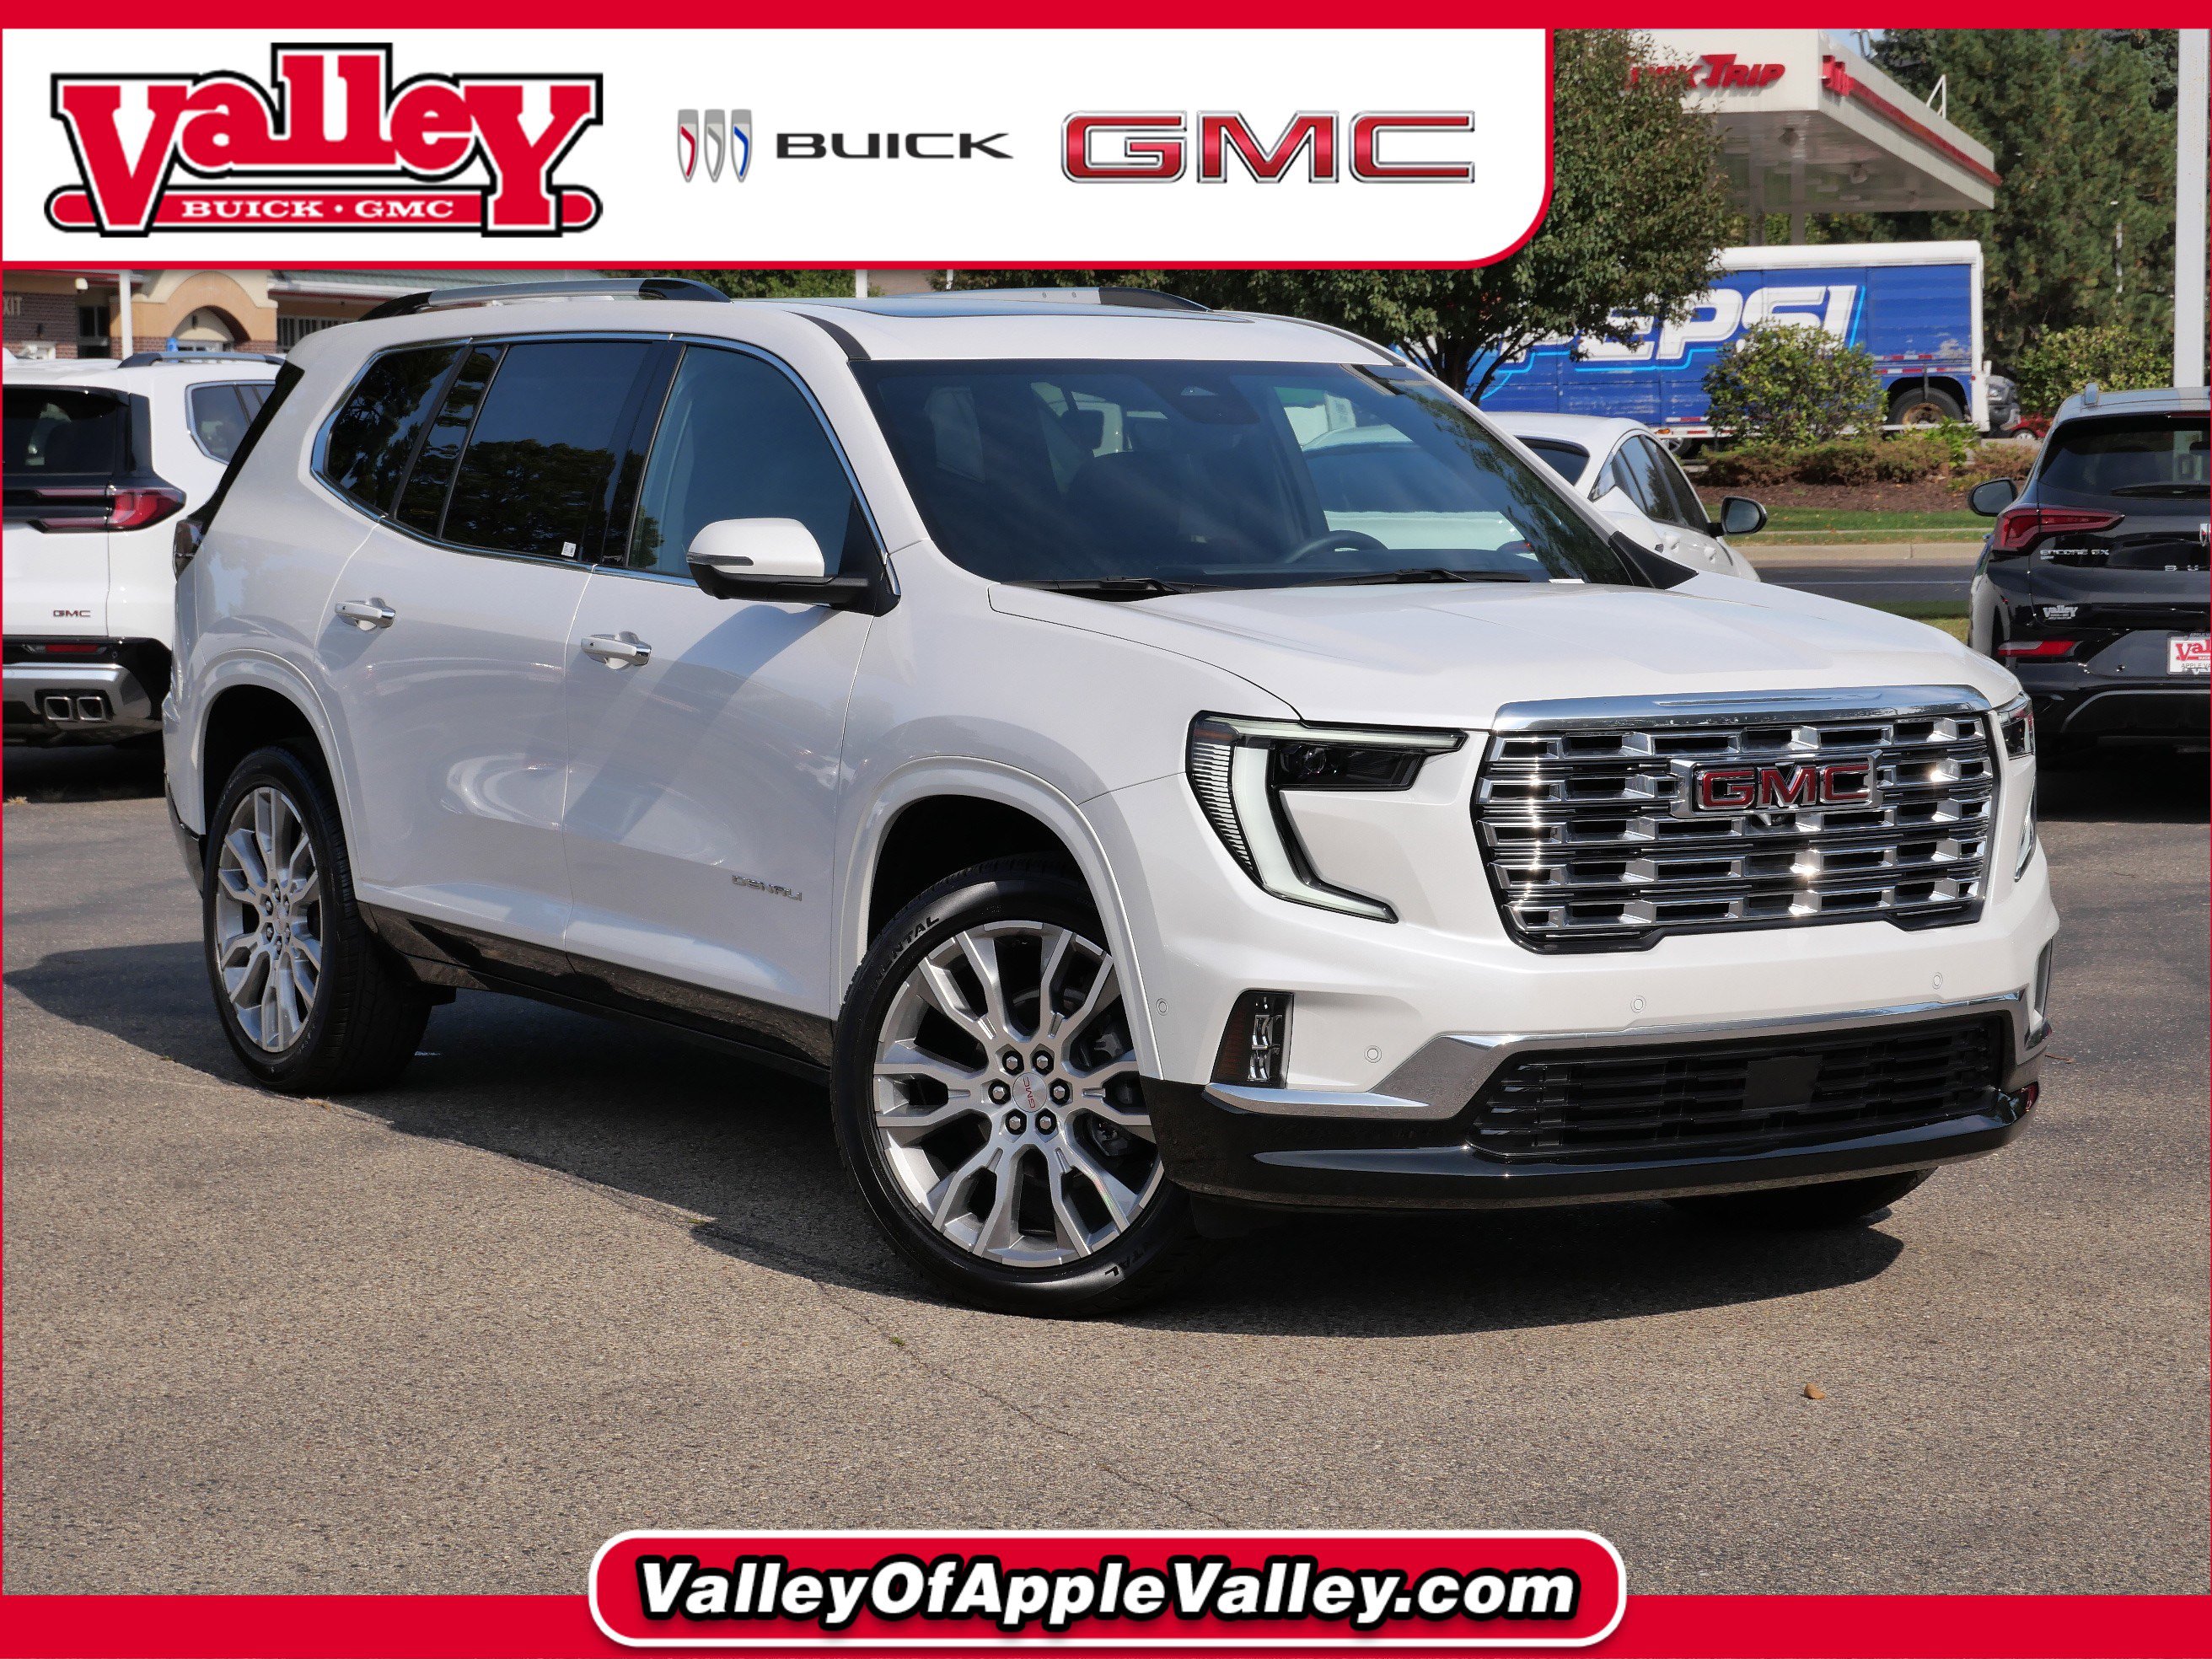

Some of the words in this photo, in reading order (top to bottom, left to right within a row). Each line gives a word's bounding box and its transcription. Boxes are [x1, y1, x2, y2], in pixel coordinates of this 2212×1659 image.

[3, 295, 23, 316] XIT
[1697, 763, 1870, 810] GMC
[1023, 1076, 1036, 1109] GMC
